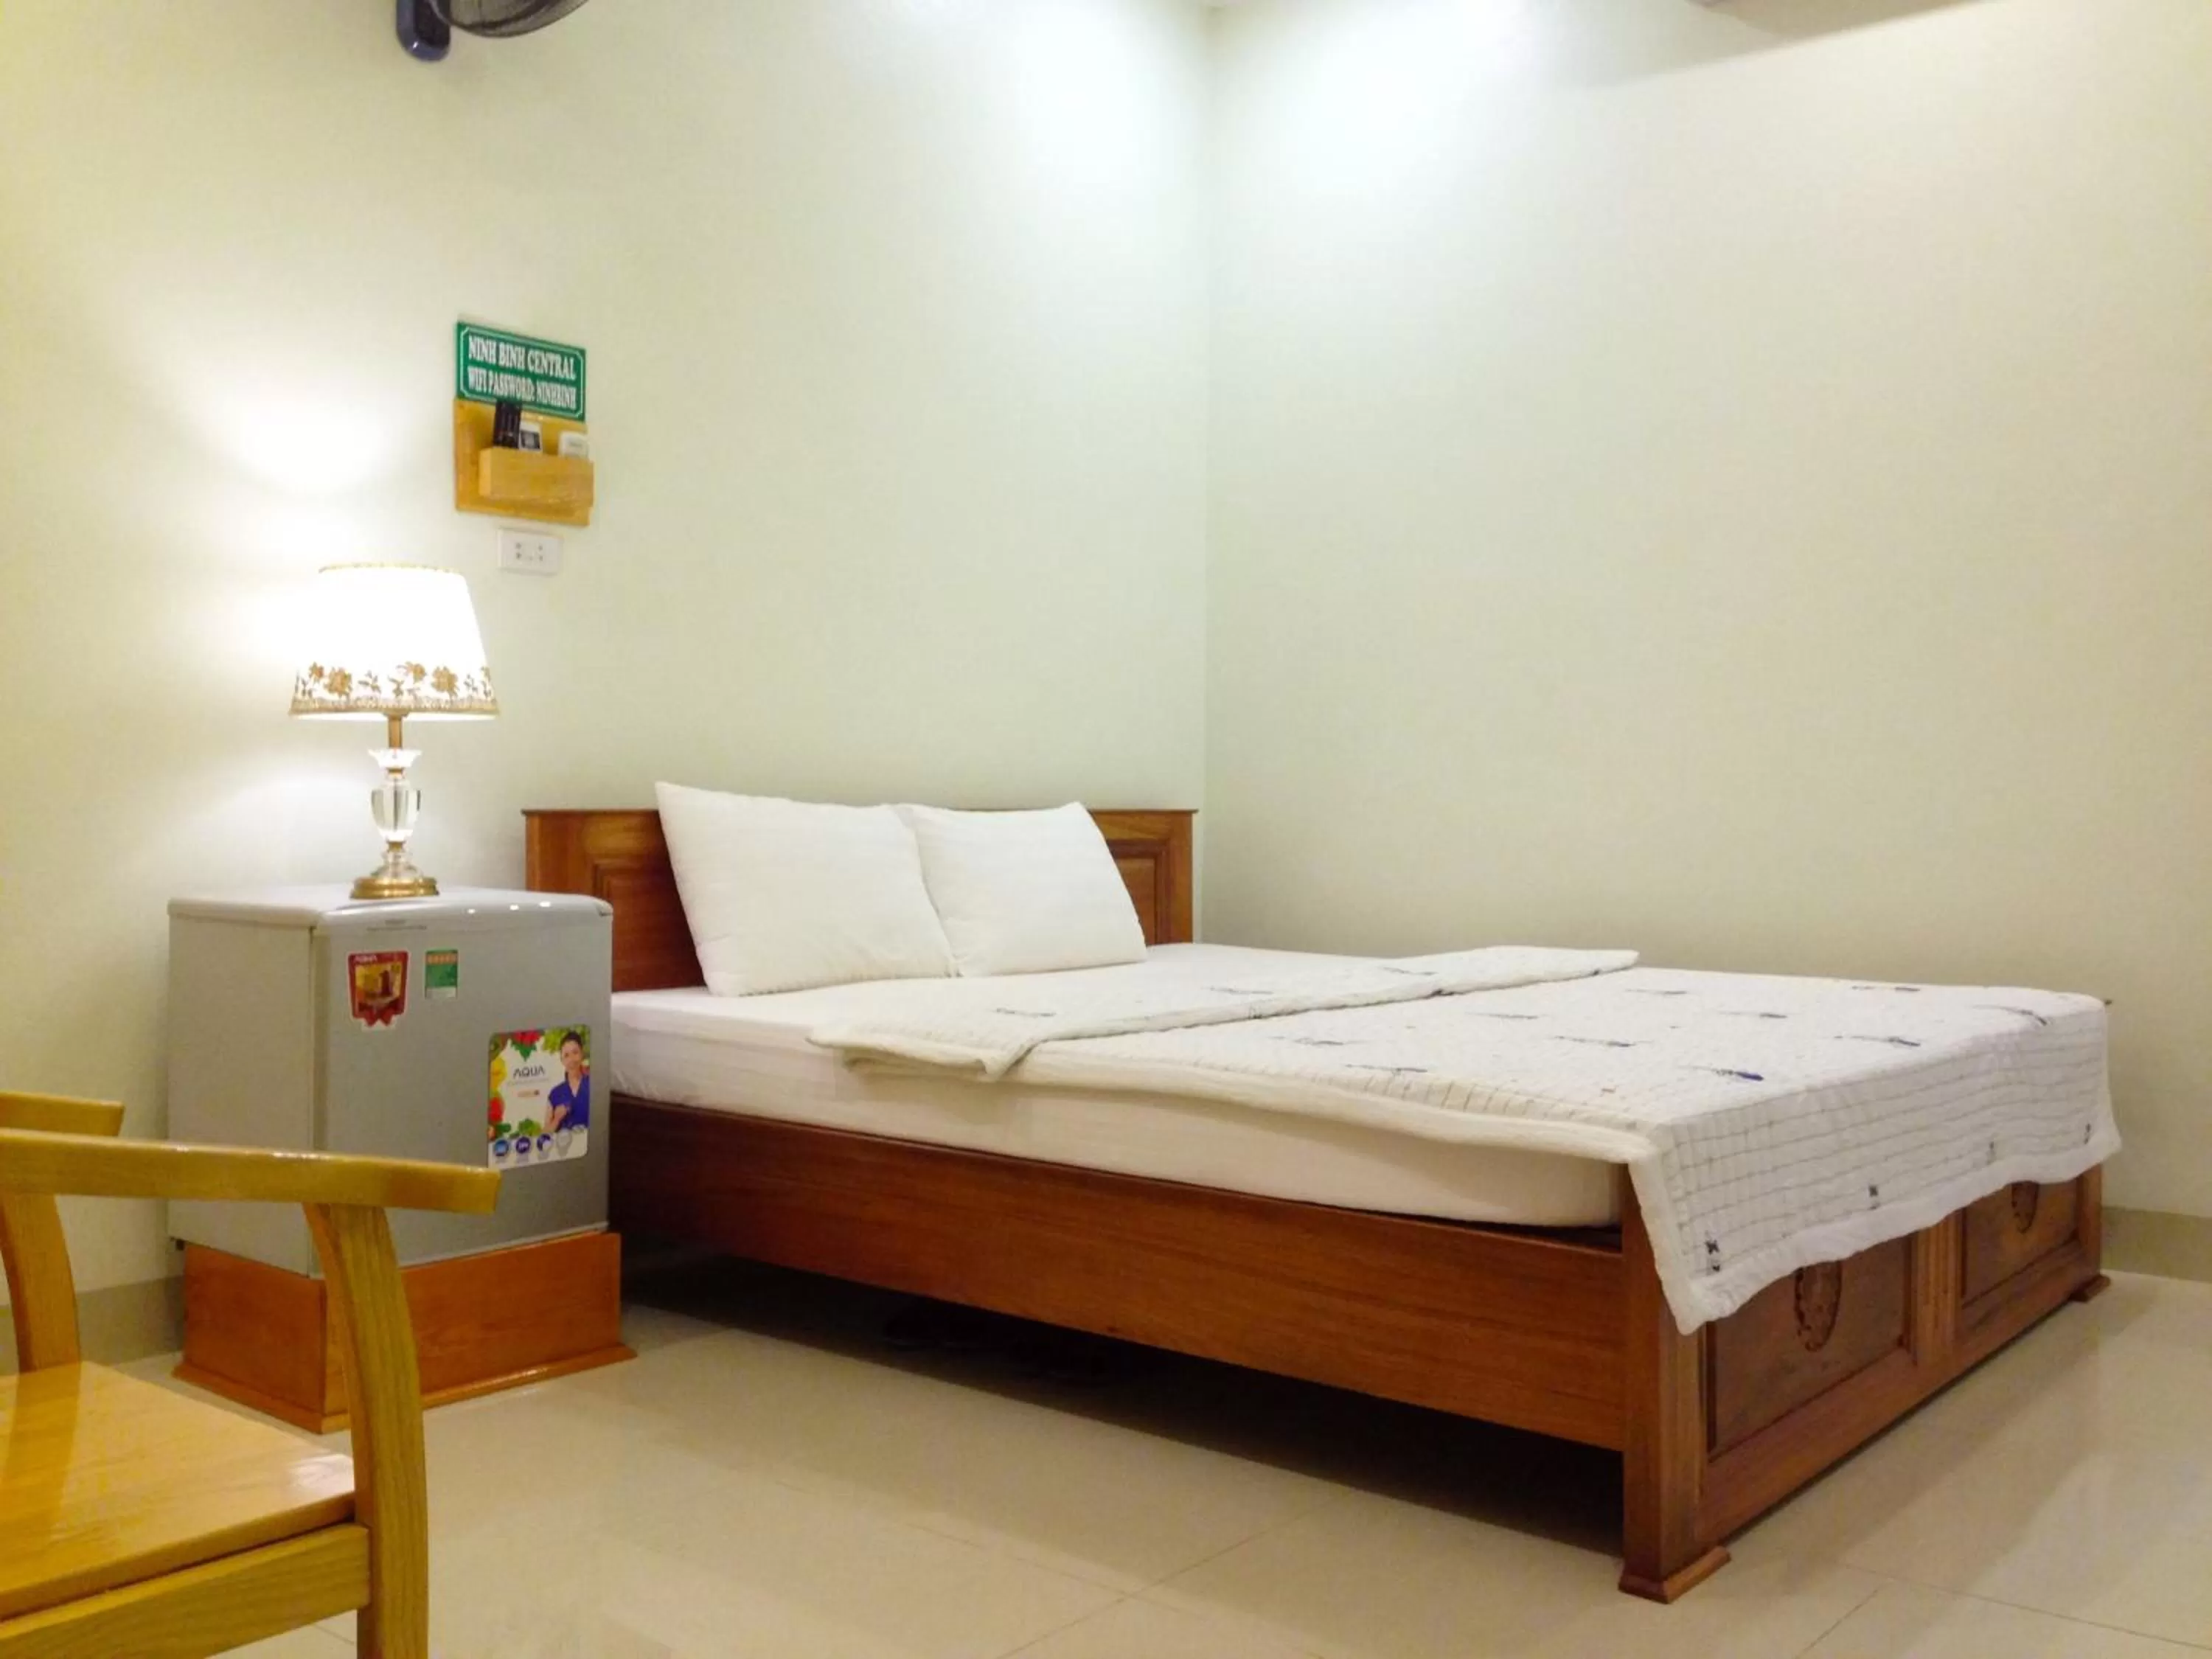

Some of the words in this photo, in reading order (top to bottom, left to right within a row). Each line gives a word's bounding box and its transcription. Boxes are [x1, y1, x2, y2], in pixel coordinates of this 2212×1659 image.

[468, 334, 497, 364] NINH
[498, 341, 526, 370] BINH
[527, 349, 577, 380] CENTRAL
[513, 1064, 546, 1079] AQUA
